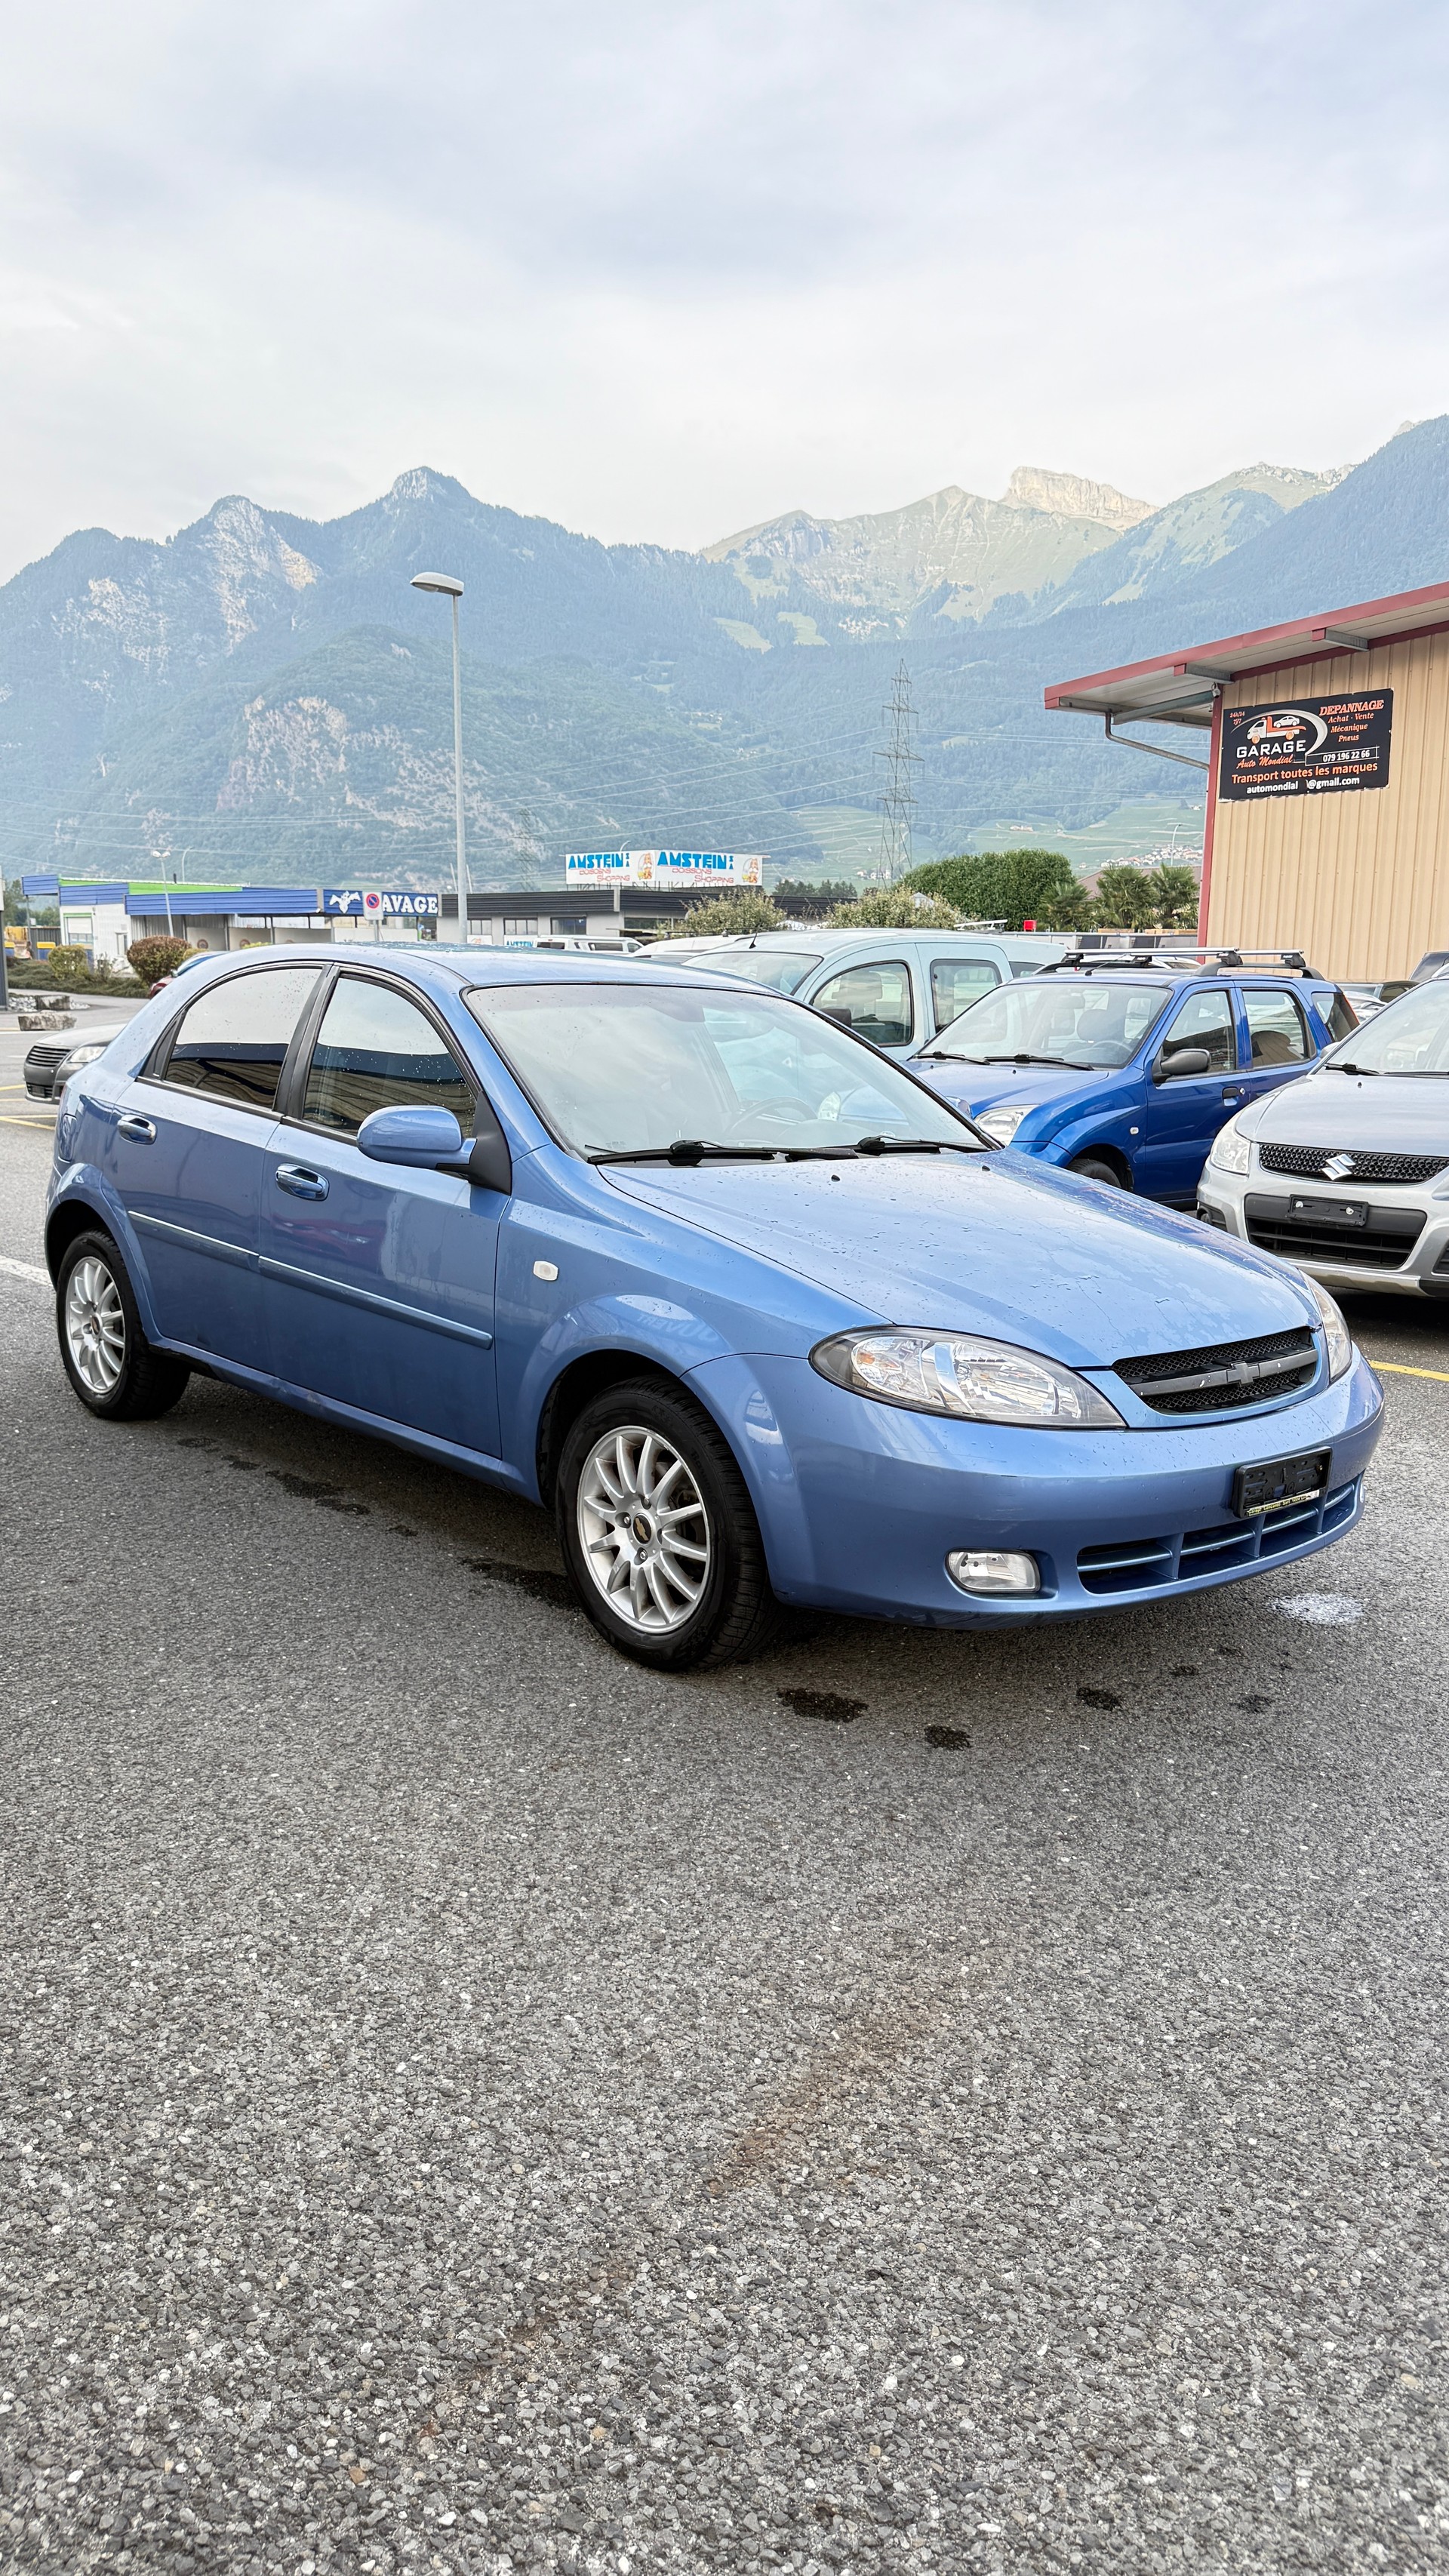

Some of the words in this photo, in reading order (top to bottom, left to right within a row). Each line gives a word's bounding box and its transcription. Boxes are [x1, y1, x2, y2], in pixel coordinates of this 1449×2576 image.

[1319, 700, 1384, 716] DEPANNAGE
[1331, 723, 1368, 733] Mécanique
[1236, 740, 1306, 758] GARAGE
[1323, 754, 1336, 762] 079
[1337, 752, 1350, 761] 196
[1351, 750, 1360, 759] 22
[1361, 749, 1371, 758] 66
[1236, 759, 1256, 769] Auto
[1259, 754, 1294, 767] Mondial
[1232, 771, 1278, 783] Transport
[1281, 768, 1312, 779] toutes
[1315, 765, 1330, 776] les
[1332, 762, 1378, 774] marques
[1247, 781, 1298, 793] automondial
[568, 853, 623, 869] AMSTEIN
[657, 851, 727, 869] AMSTEIN
[383, 894, 438, 913] AVAGE
